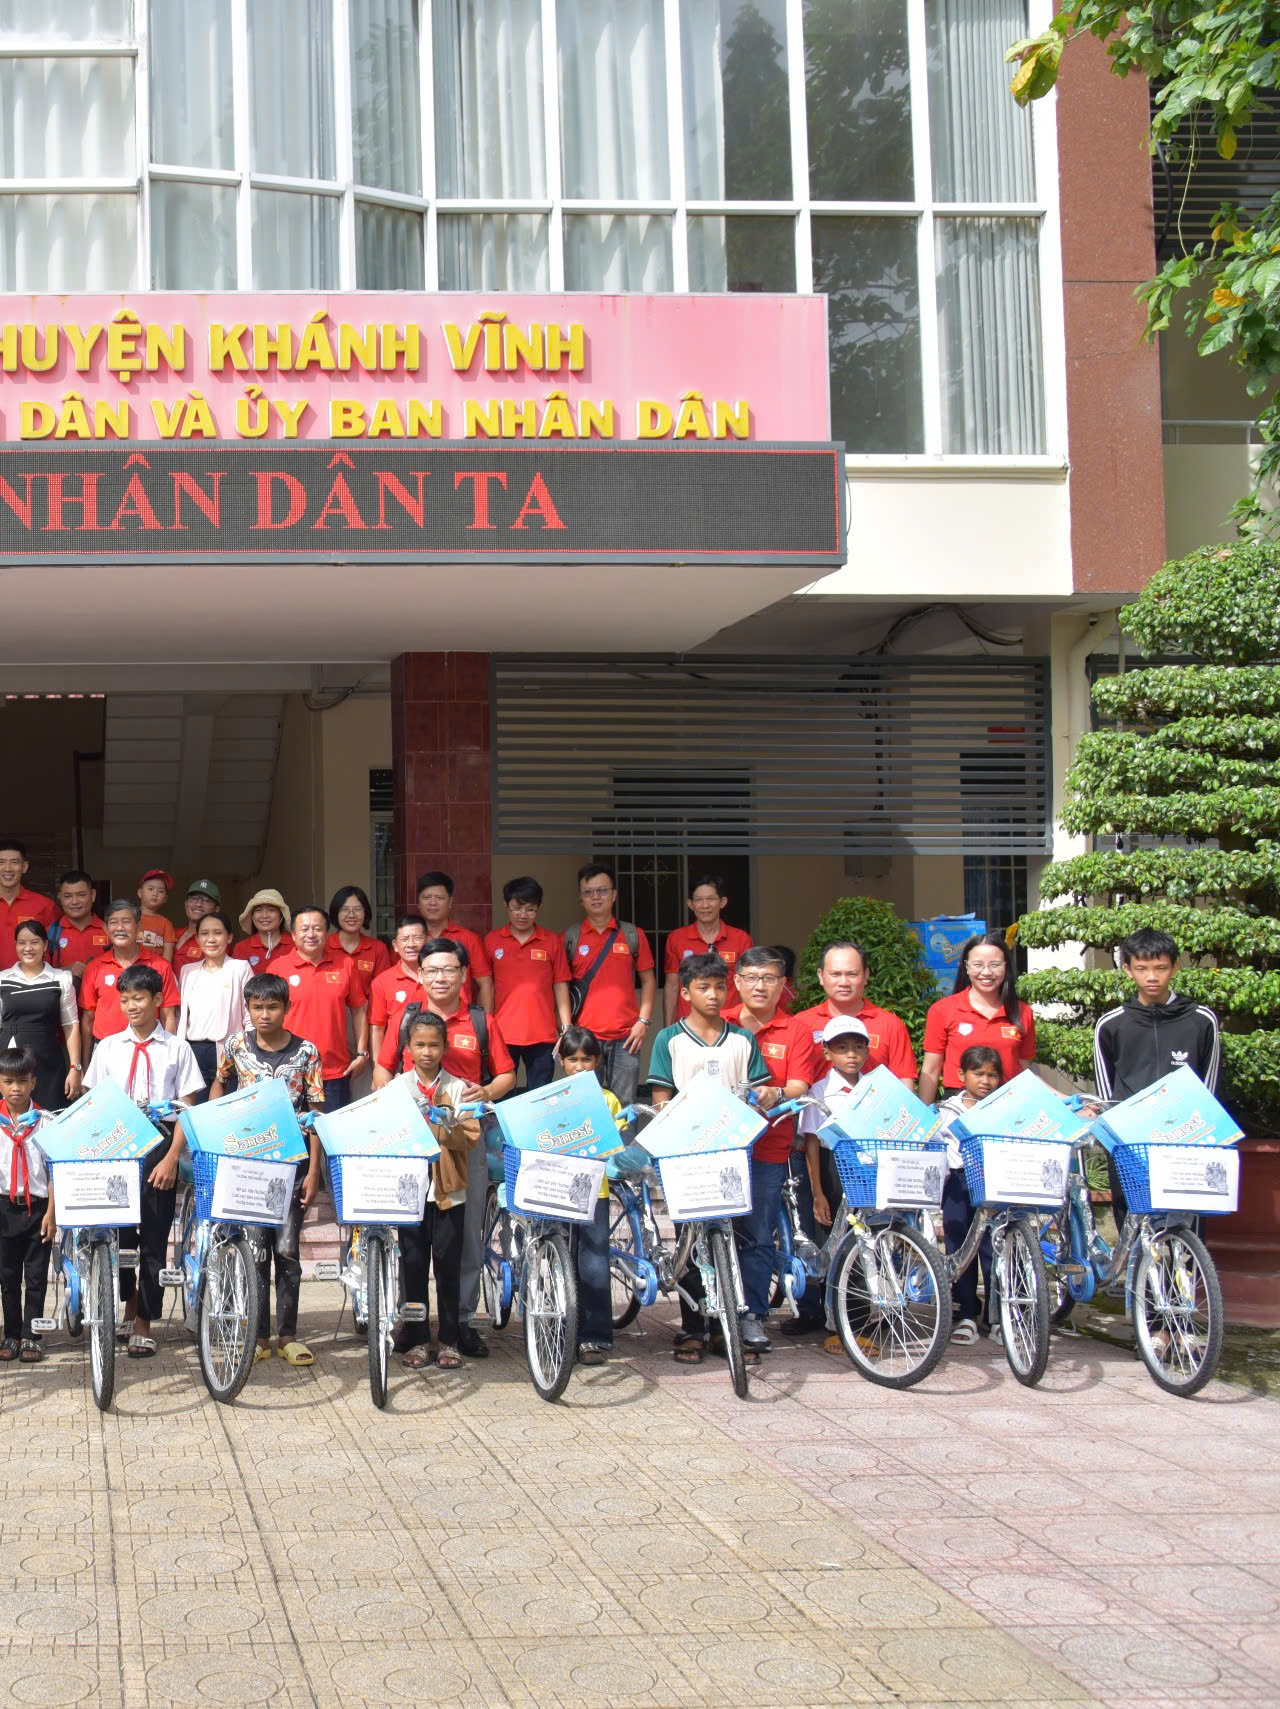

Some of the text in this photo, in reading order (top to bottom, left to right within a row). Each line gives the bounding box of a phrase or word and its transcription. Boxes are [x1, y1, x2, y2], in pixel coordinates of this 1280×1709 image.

[209, 310, 421, 370] KHÁNH
[443, 312, 586, 370] VĨNH
[20, 391, 129, 439] DÂN
[151, 390, 217, 438] VÀ
[236, 384, 310, 438] ỦY
[330, 399, 444, 437] BAN
[465, 390, 615, 438] NHÂN
[638, 390, 751, 438] DÂN
[251, 452, 431, 530] DÂN
[454, 472, 568, 529] TA
[223, 1122, 278, 1154] Sanest
[536, 1116, 594, 1151] Sanest
